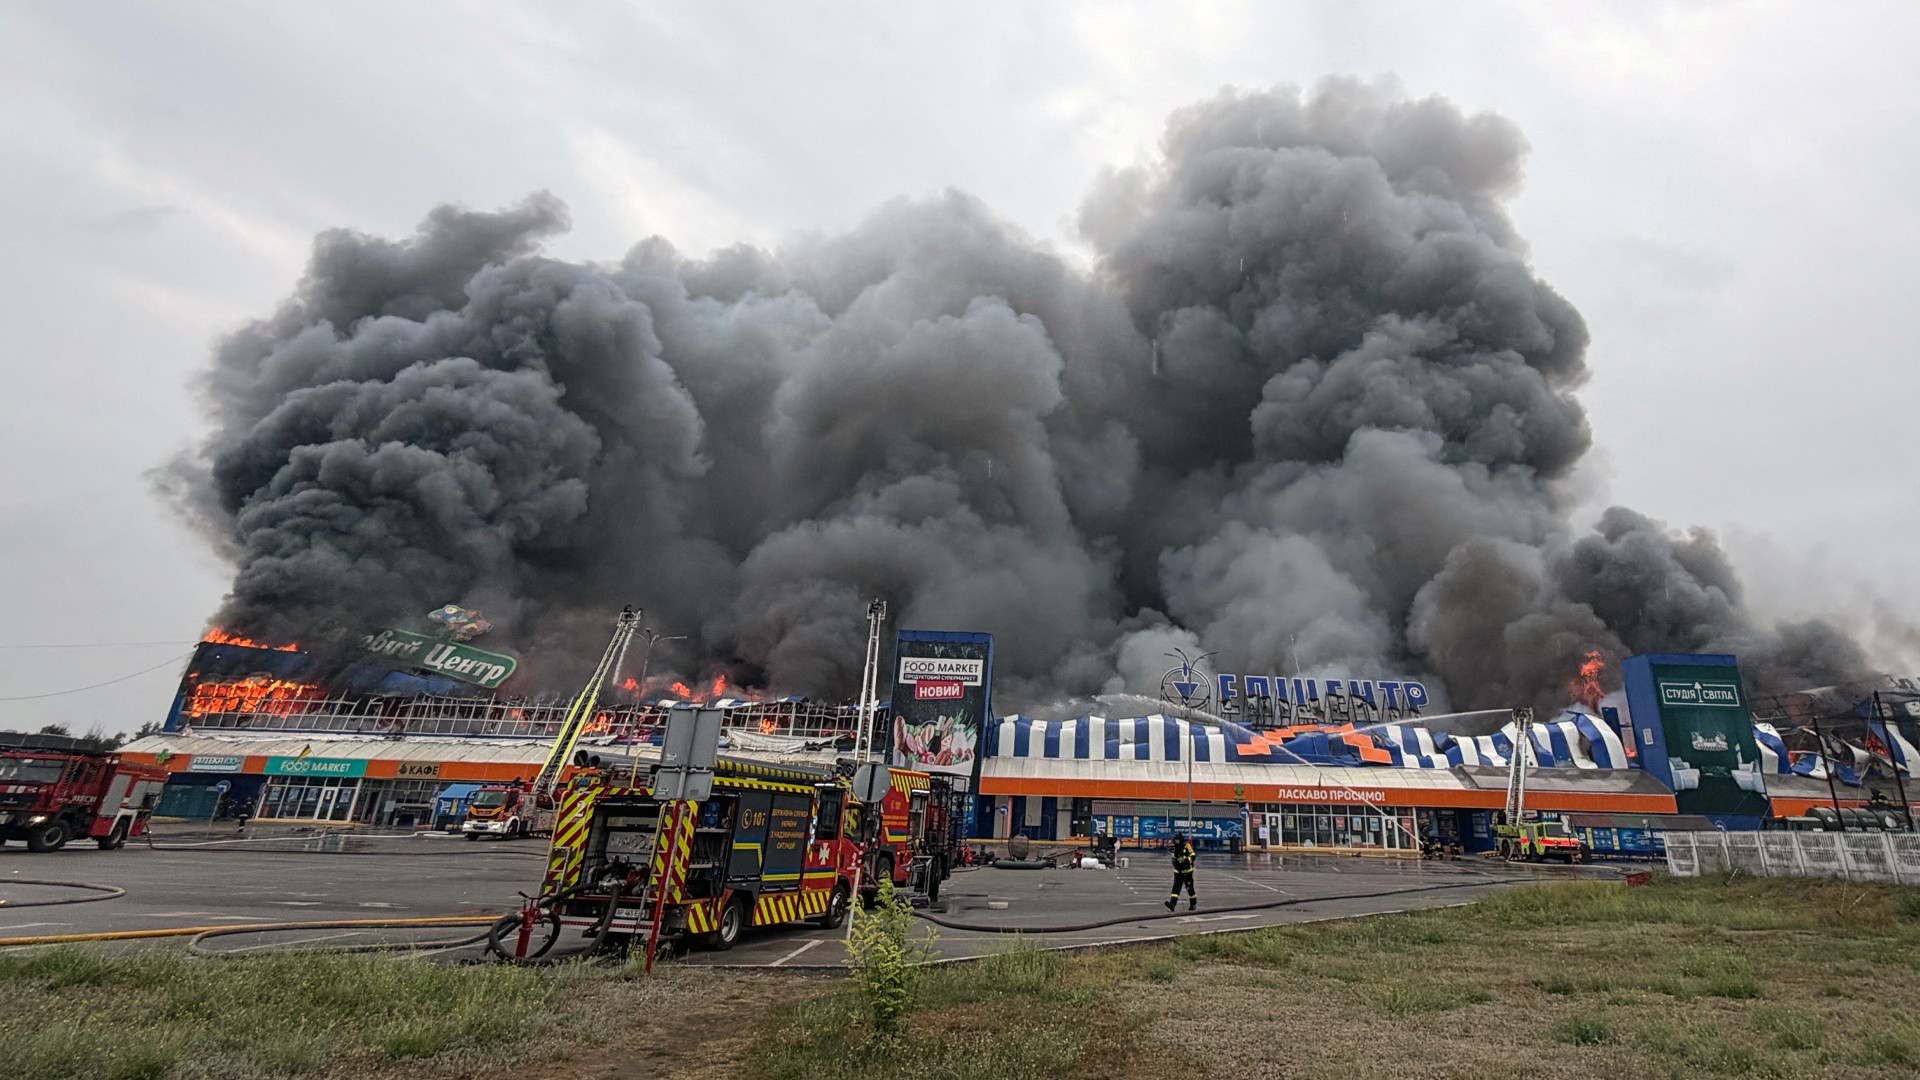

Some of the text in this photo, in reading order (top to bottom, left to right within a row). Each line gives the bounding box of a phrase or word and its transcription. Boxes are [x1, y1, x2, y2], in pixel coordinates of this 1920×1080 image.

[424, 643, 505, 685] Центр
[904, 662, 979, 673] FOOD MARKET
[919, 683, 960, 697] НОВИЙ
[1666, 689, 1734, 700] СТУДІЯ СВІТЛА
[1217, 673, 1429, 722] ЕПІЦЕНТР
[280, 761, 351, 772] FOOD MARKET
[408, 765, 439, 775] КАФЕ
[1278, 789, 1386, 801] ЛАСКАВО ПРОСИМО!
